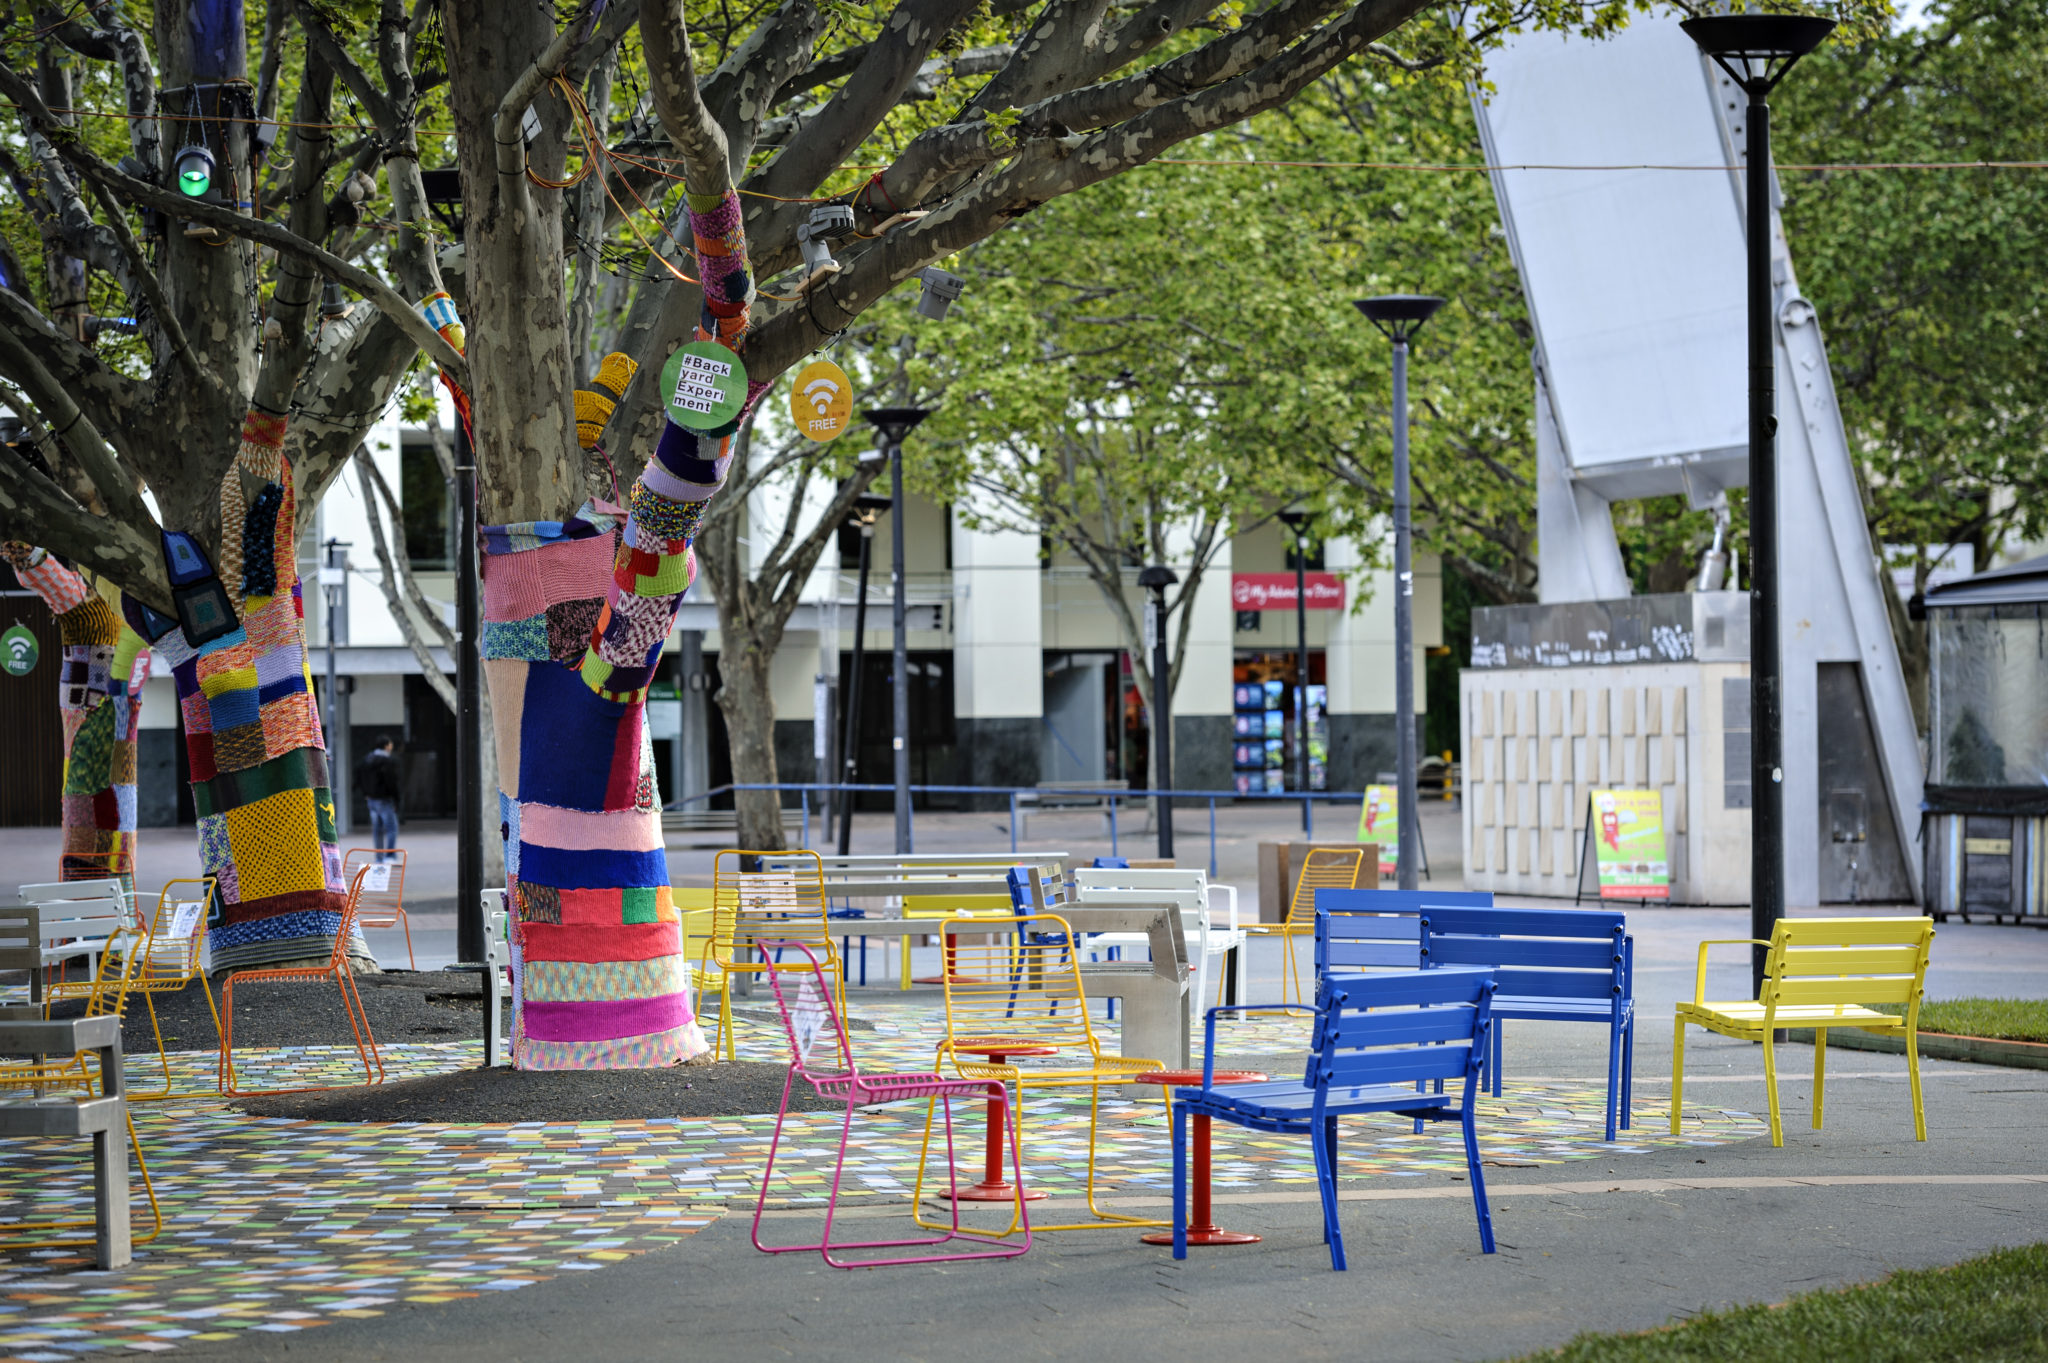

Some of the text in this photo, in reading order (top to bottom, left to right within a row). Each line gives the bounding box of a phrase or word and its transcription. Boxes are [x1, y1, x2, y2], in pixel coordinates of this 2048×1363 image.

[684, 356, 729, 375] #Back
[681, 369, 714, 384] yard
[677, 381, 725, 400] Experi
[674, 396, 711, 412] ment
[808, 417, 838, 432] FREE
[8, 660, 28, 669] FREE
